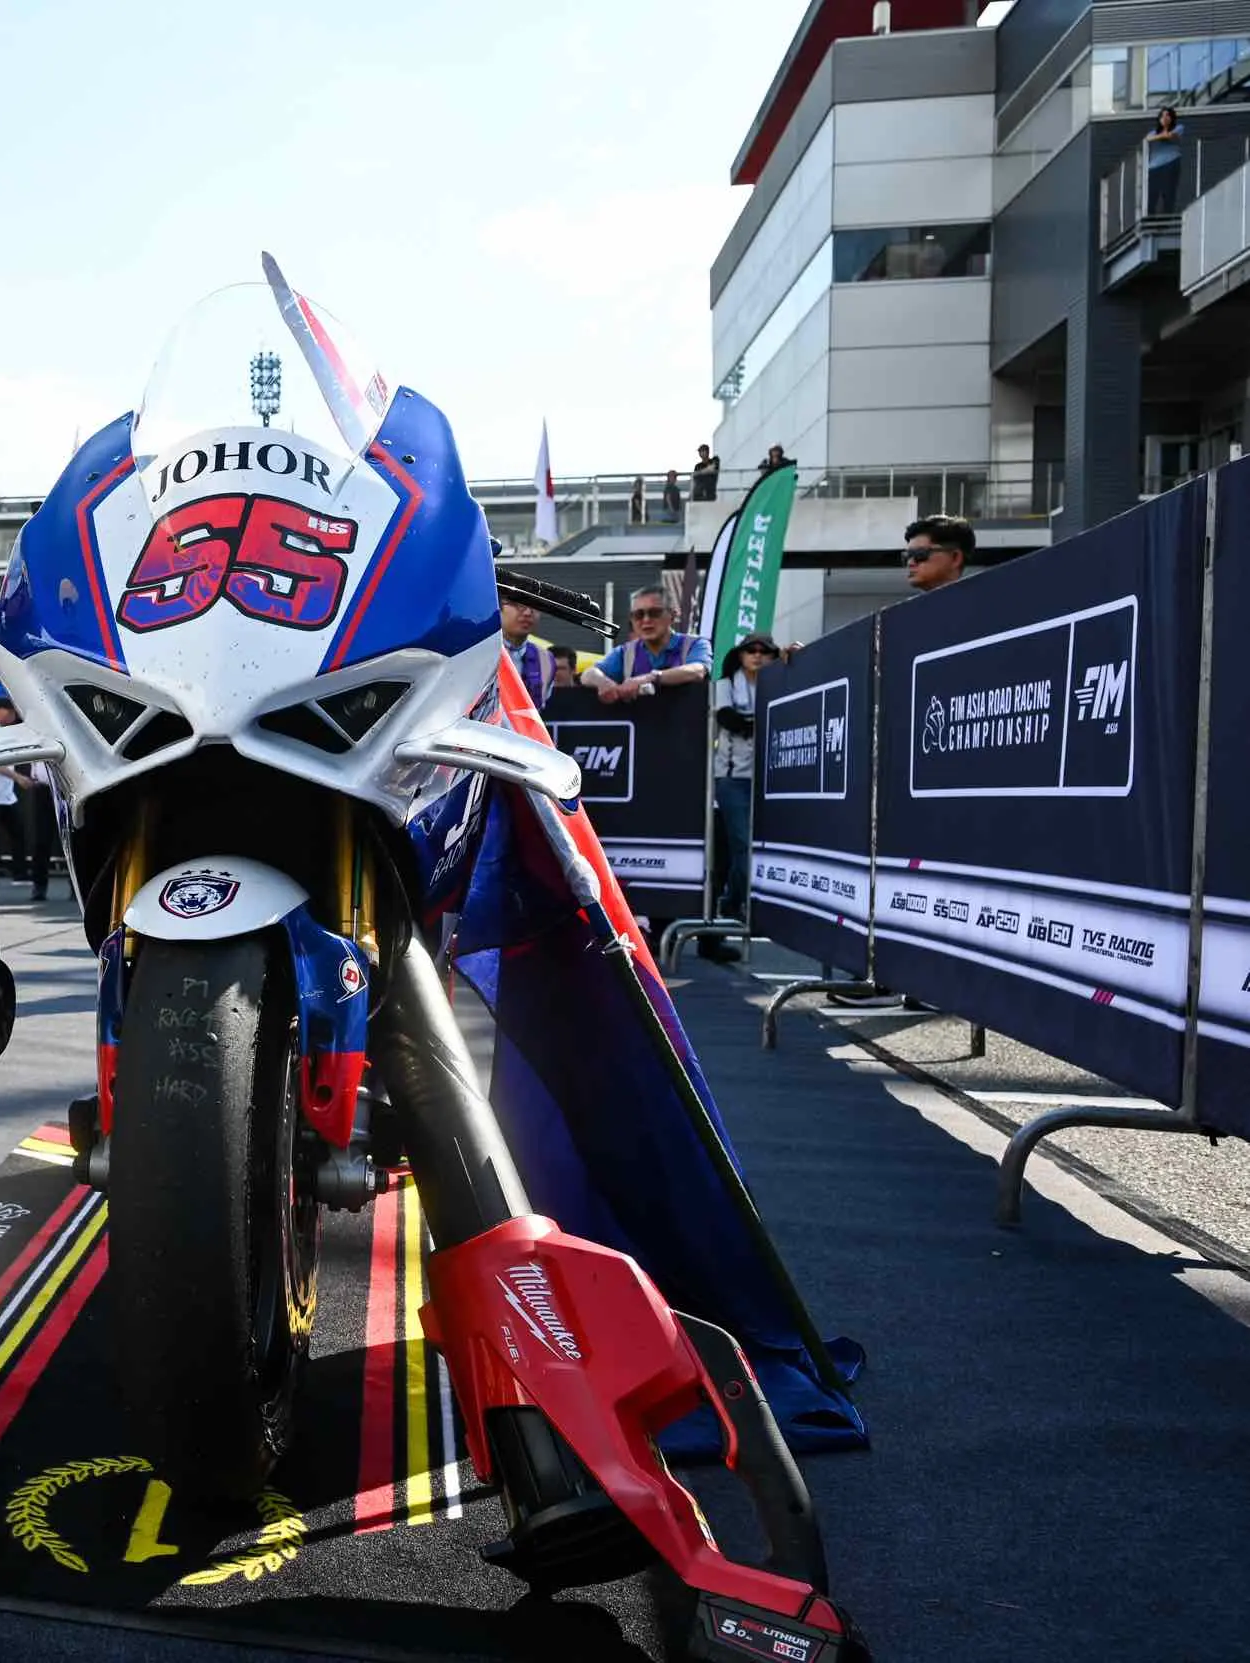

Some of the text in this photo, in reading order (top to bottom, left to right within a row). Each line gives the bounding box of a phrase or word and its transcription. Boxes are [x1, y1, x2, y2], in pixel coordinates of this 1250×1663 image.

[151, 441, 333, 502] JOHOR
[115, 492, 360, 635] 55
[950, 679, 1051, 722] FIM ASIA ROAD RACING
[1074, 659, 1128, 721] FIM
[825, 716, 845, 752] FIM
[949, 713, 1050, 752] CHAMPIONSHIP
[572, 746, 624, 771] FIM
[906, 893, 928, 914] 1000
[933, 901, 969, 923] SS 600
[976, 909, 1020, 934] AP 250
[1027, 920, 1073, 948] UB 150
[1082, 928, 1155, 959] TVS RACING
[504, 1262, 582, 1361] Milwaukee
[501, 1325, 520, 1365] FUEL
[774, 1640, 807, 1661] M18
